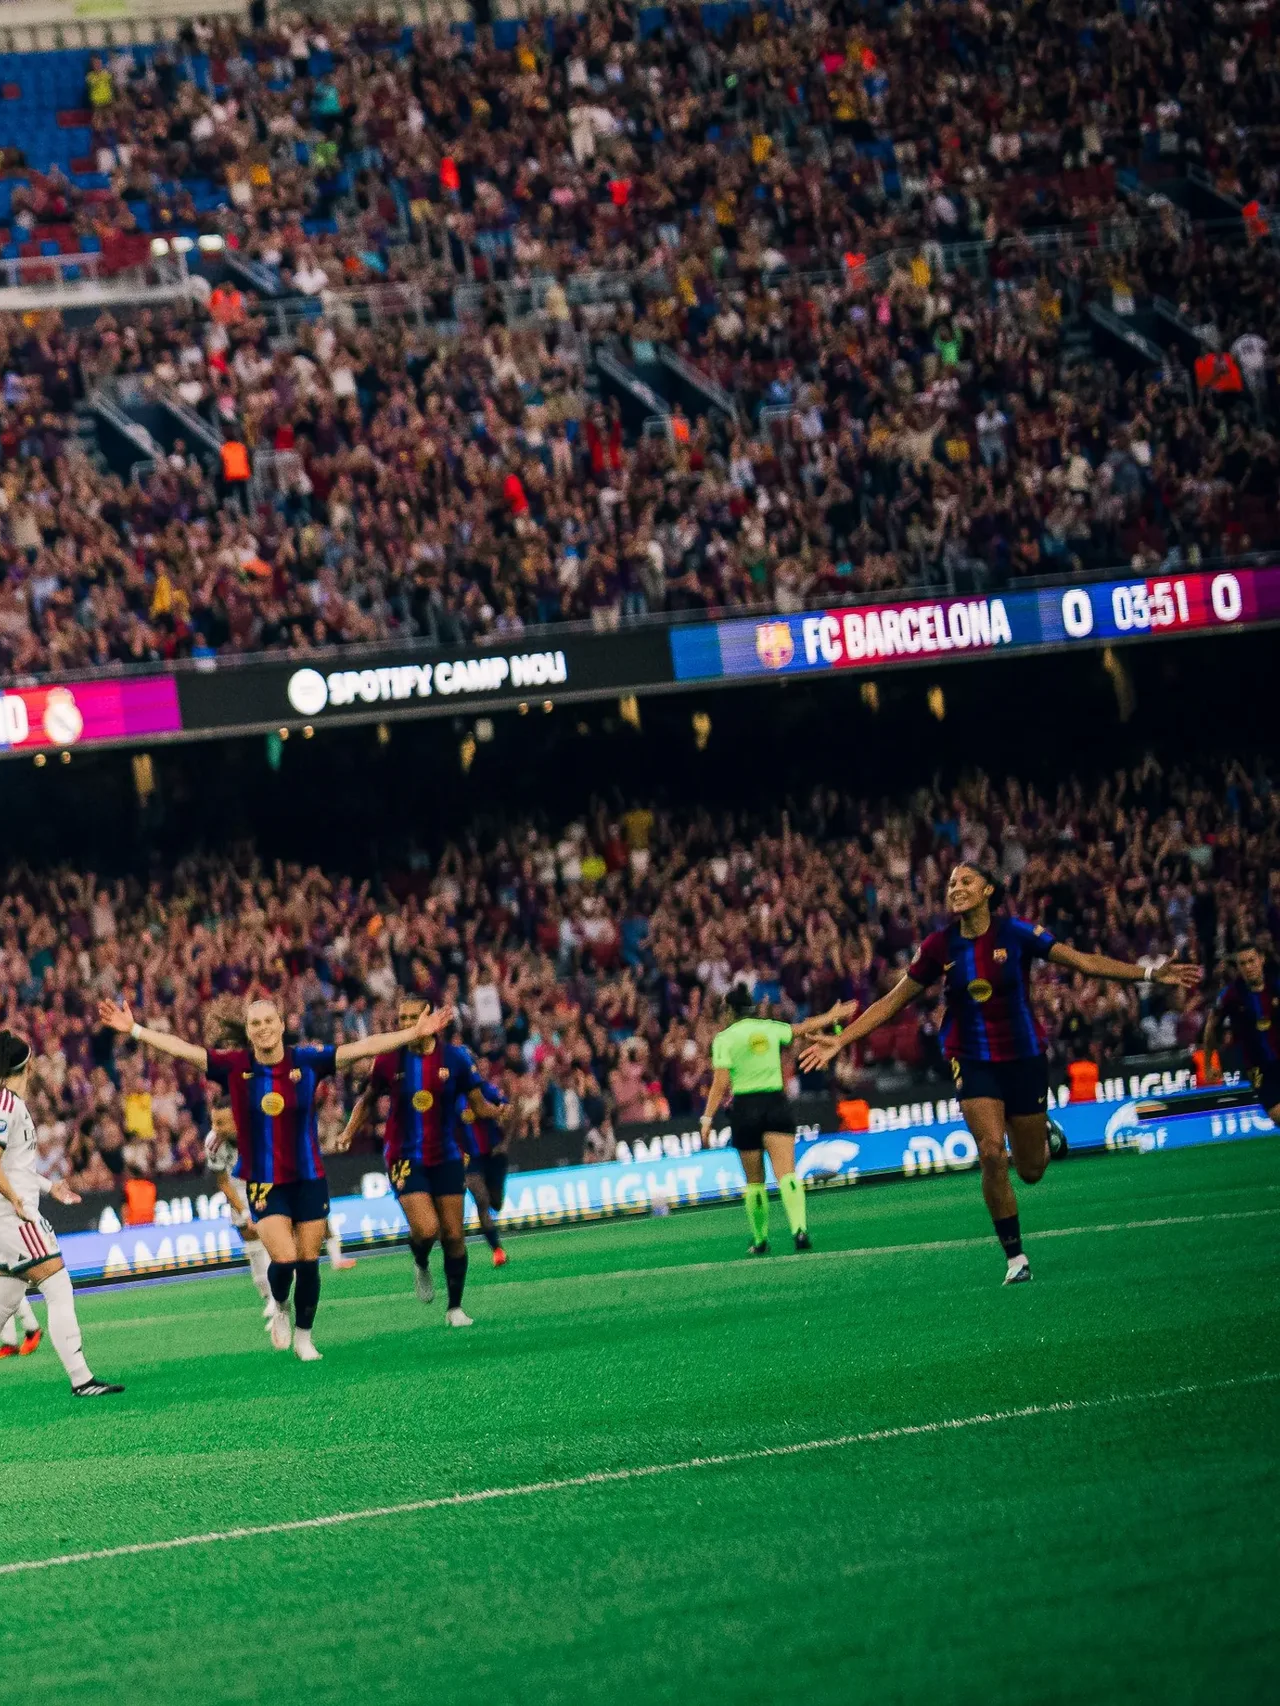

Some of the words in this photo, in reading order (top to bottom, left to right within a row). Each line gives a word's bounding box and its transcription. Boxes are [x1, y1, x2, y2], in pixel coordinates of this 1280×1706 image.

[802, 616, 842, 664] FC
[843, 598, 1013, 661] BARCELONA
[1062, 588, 1093, 638] 0
[1112, 580, 1189, 631] 03:51
[1211, 572, 1242, 622] 0
[326, 663, 433, 706] SPOTIFY
[434, 656, 510, 695] CAMP
[510, 650, 568, 688] NOU
[501, 1165, 704, 1223] MBILIGHT
